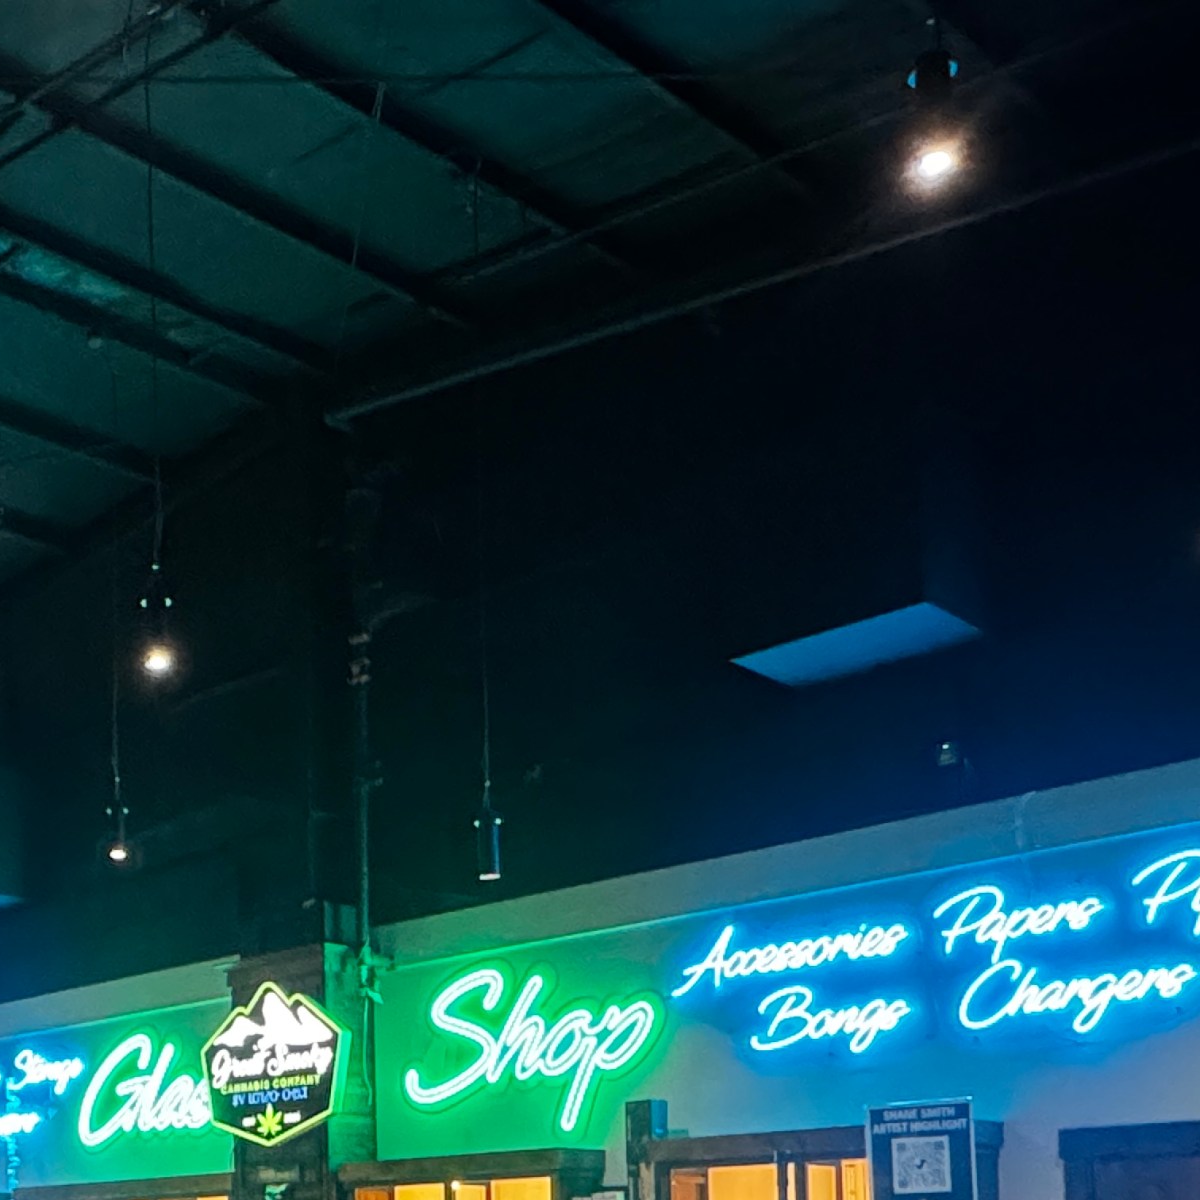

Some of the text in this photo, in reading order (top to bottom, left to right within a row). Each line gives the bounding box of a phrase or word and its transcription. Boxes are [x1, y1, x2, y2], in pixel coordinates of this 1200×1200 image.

[671, 924, 909, 997] Accessories
[932, 885, 1105, 965] Papers
[404, 969, 654, 1132] Shop
[750, 959, 1198, 1053] Bongs Chargers
[78, 1033, 211, 1147] Glas
[272, 1073, 321, 1089] COMPANY
